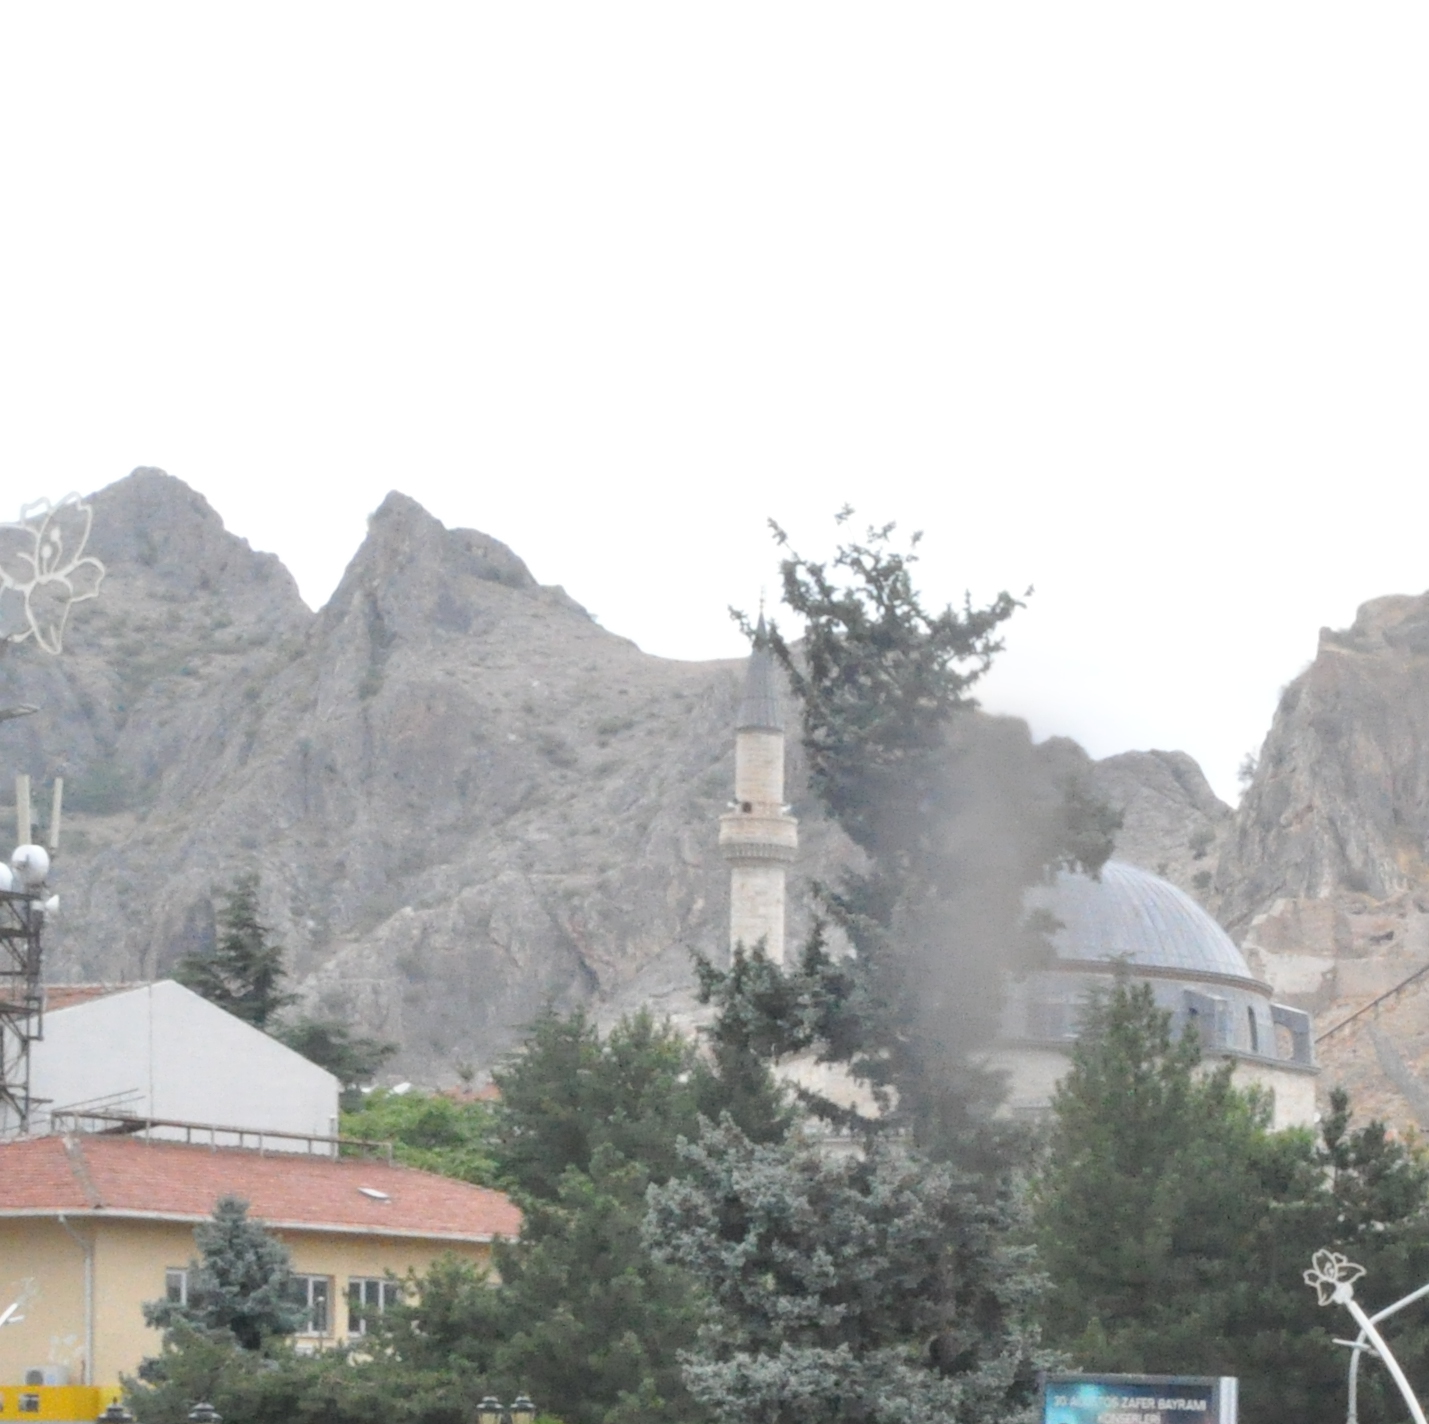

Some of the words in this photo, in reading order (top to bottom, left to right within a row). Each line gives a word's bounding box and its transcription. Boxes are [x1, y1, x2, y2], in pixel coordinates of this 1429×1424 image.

[1069, 1395, 1119, 1409] ATOS
[1121, 1397, 1156, 1409] ZAFER
[1157, 1398, 1207, 1411] BAYRAMI
